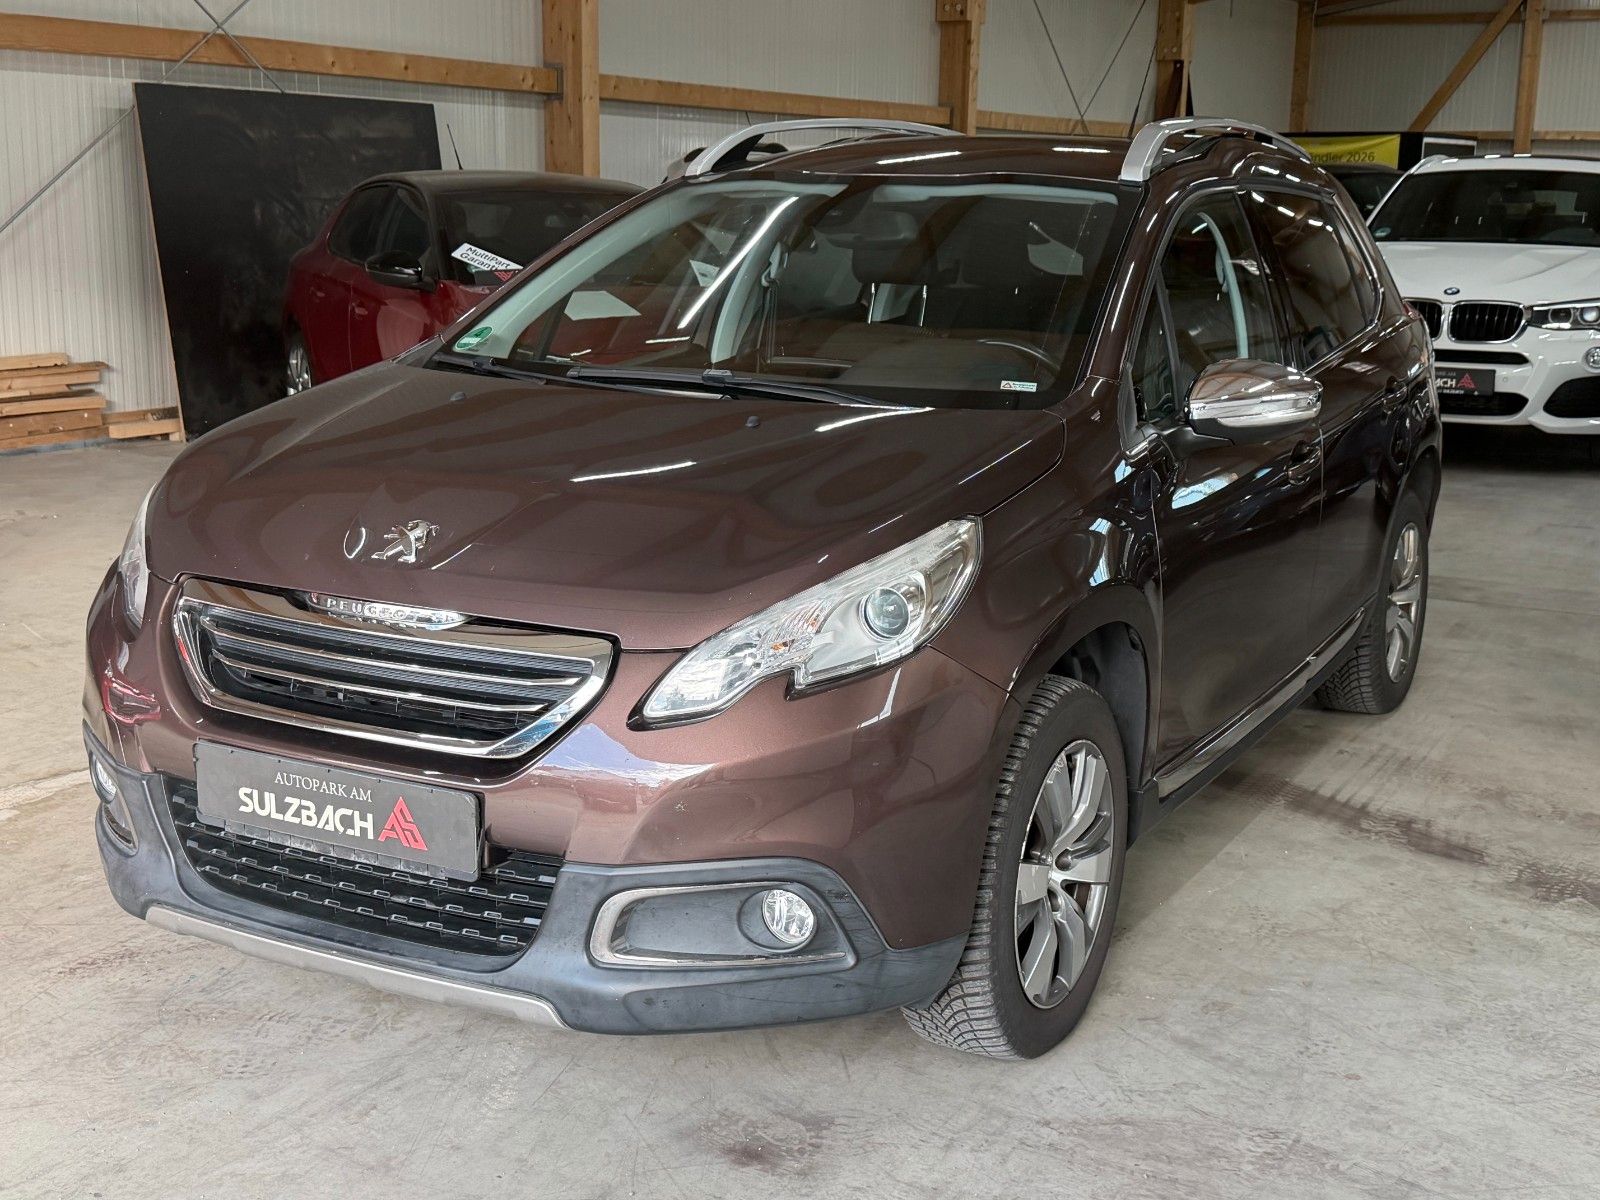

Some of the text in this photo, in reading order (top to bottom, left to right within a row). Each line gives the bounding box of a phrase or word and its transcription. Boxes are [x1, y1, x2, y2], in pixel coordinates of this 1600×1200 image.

[1346, 151, 1376, 163] 2026
[465, 246, 511, 269] MultiPart
[326, 597, 421, 621] PEUGEOT
[275, 772, 372, 803] AUTOPARK AM
[238, 786, 374, 840] SULZBACH
